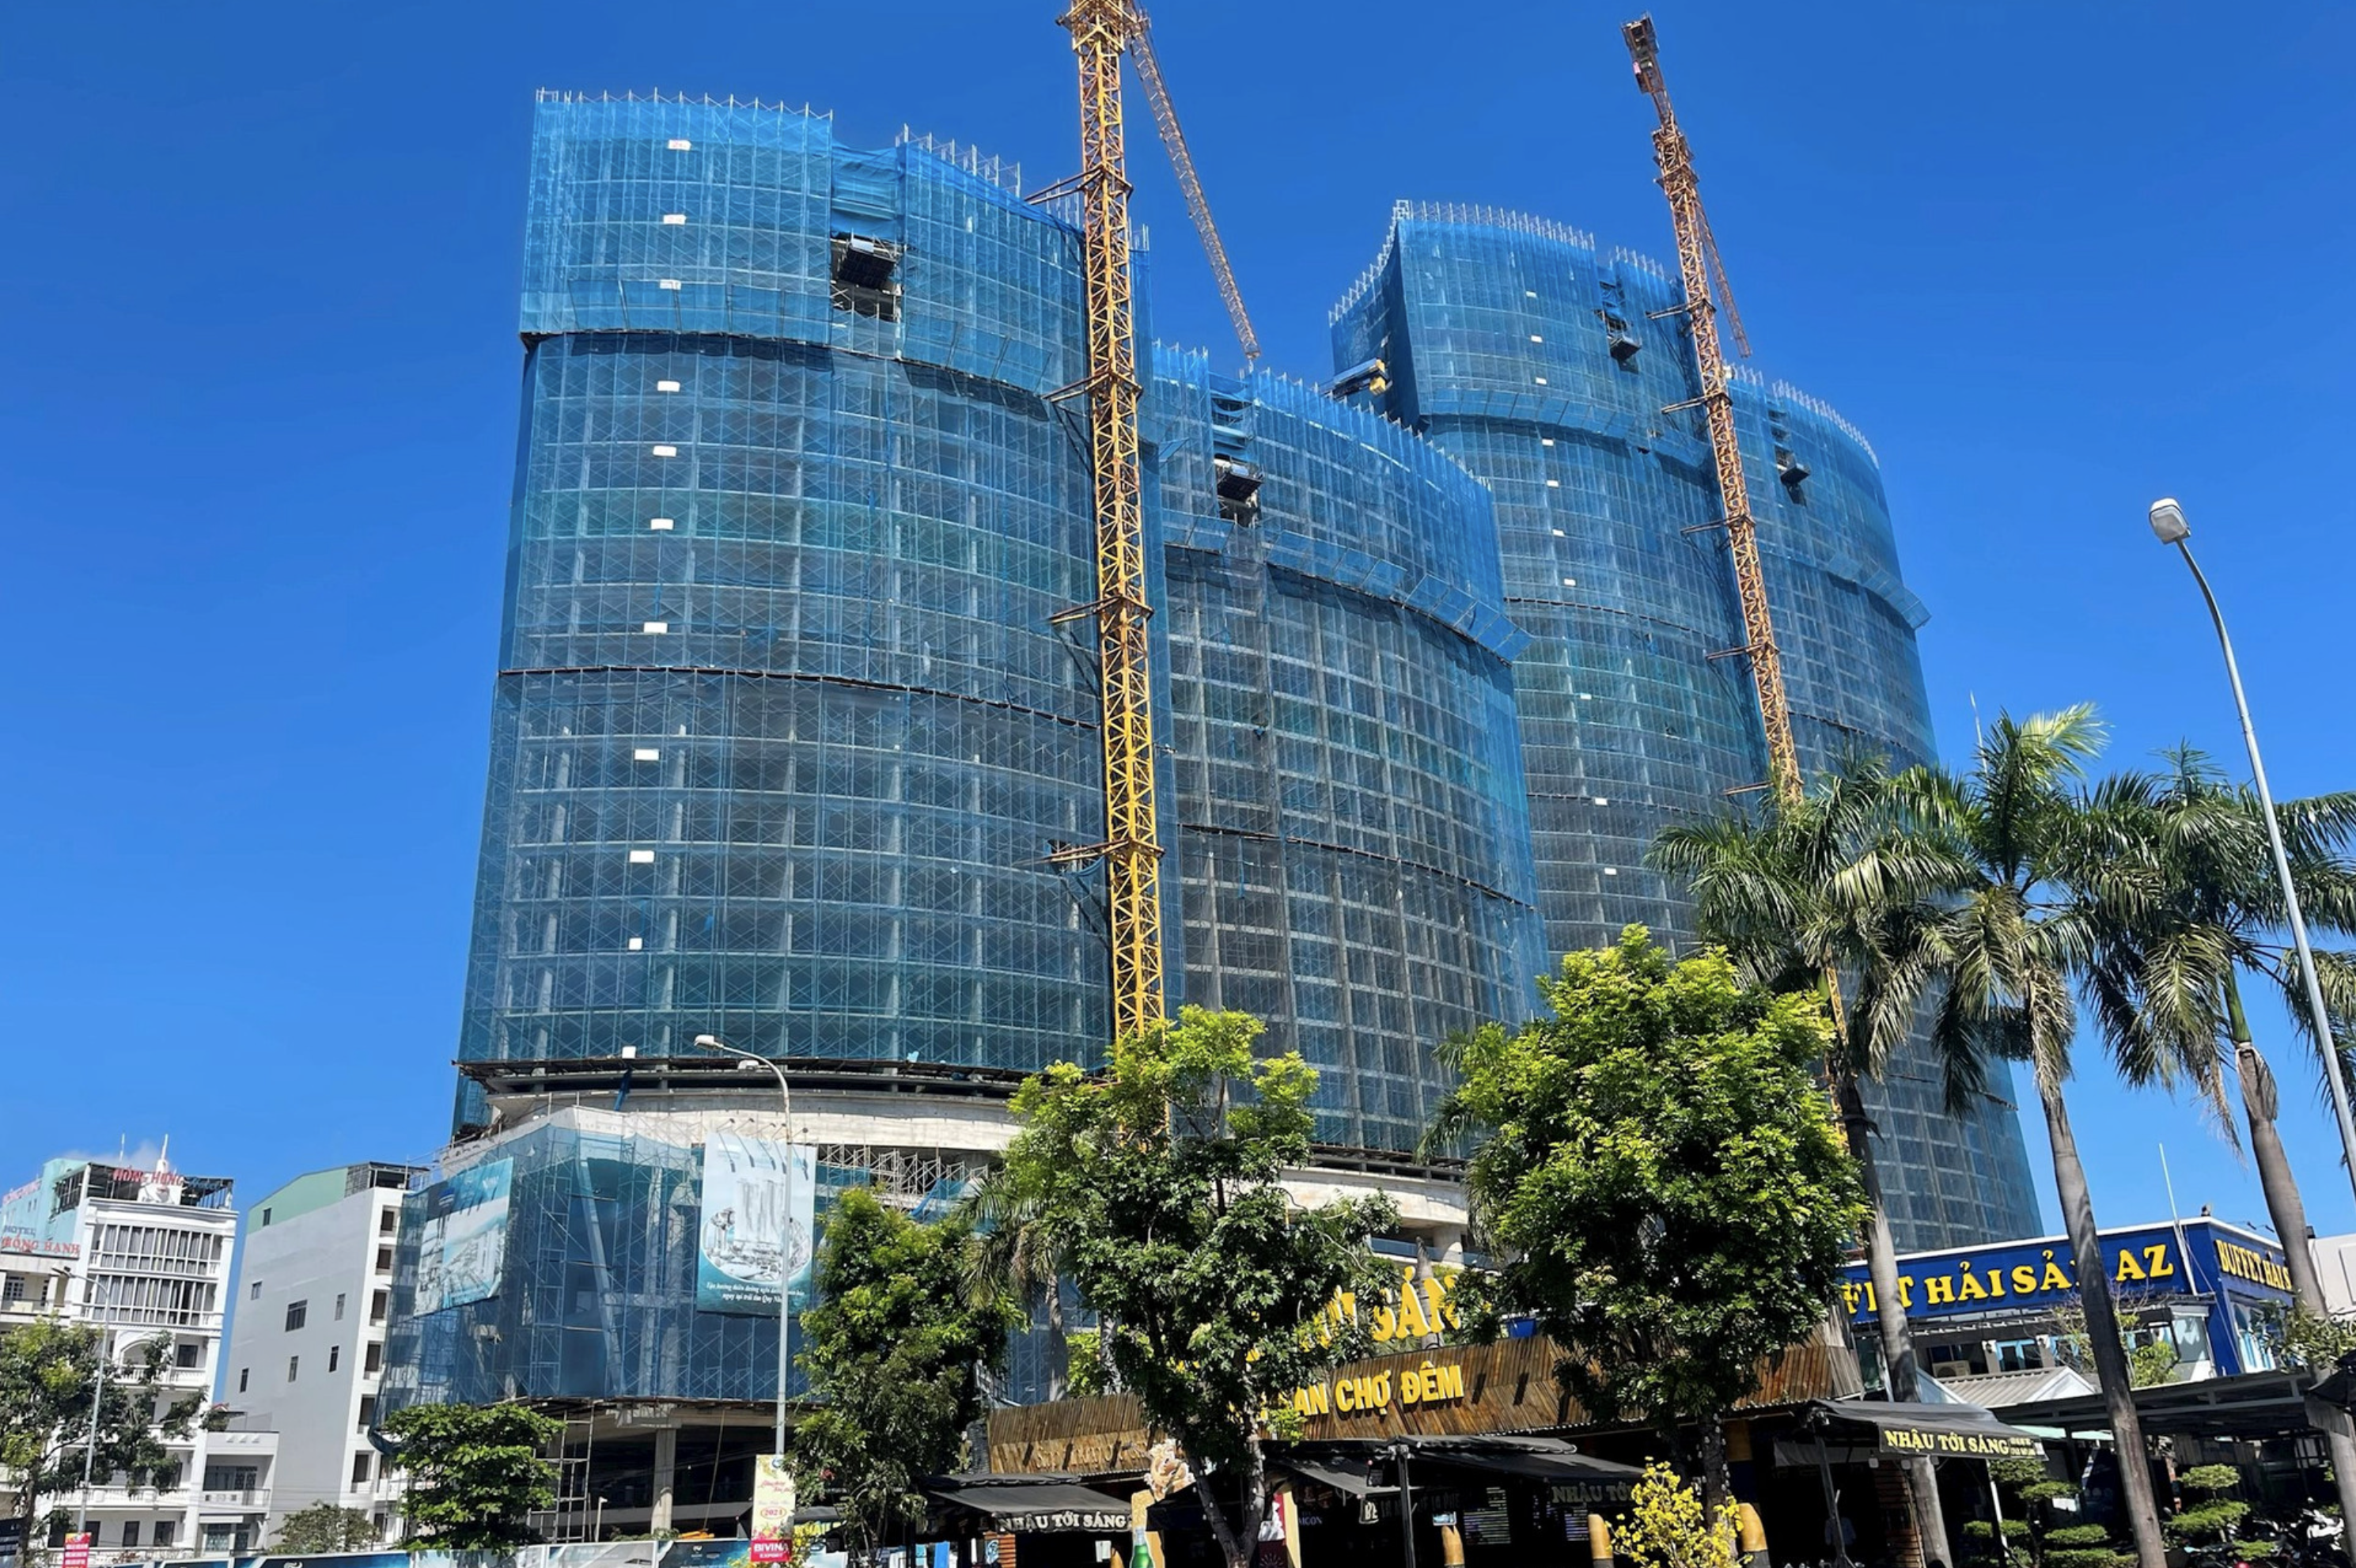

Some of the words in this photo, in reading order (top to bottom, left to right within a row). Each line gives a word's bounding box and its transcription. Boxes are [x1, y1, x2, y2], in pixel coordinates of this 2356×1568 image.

[1925, 1261, 2006, 1305] HẢI
[2011, 1249, 2079, 1293] SẢ
[2115, 1244, 2174, 1282] AZ
[2216, 1239, 2264, 1283] BUFFET
[1335, 1369, 1391, 1415] CHỢ
[1400, 1361, 1464, 1405] ĐÊM
[1884, 1427, 1934, 1452] NHẬU
[1937, 1430, 1967, 1452] TỚI
[1968, 1434, 2009, 1455] SÁNG
[1051, 1511, 1080, 1528] TỚI
[1083, 1511, 1127, 1528] SÁNG
[754, 1543, 789, 1553] BIVINA
